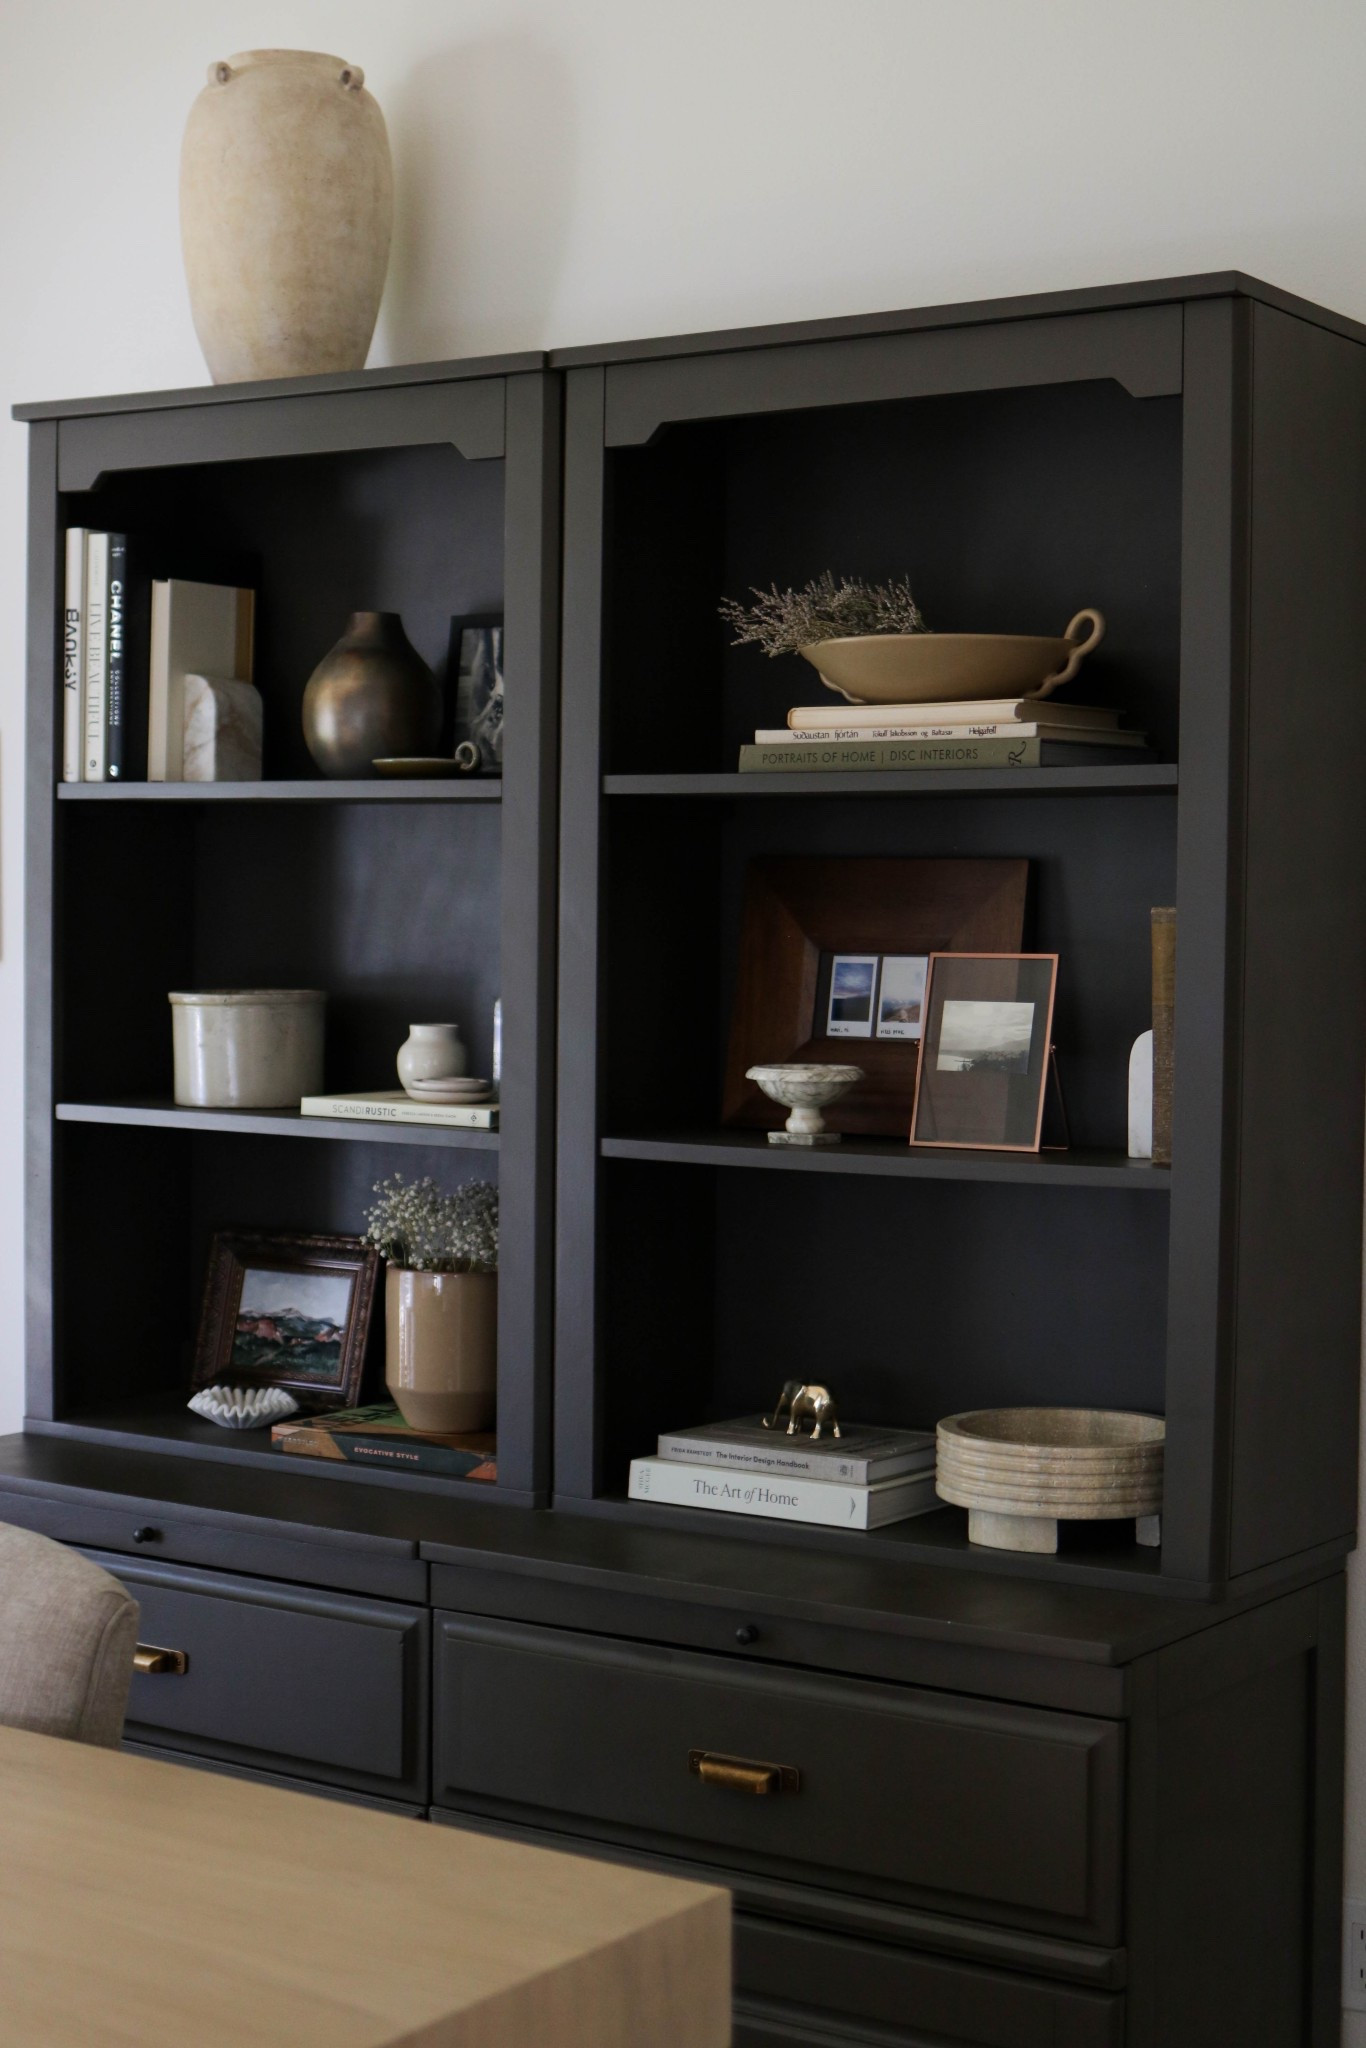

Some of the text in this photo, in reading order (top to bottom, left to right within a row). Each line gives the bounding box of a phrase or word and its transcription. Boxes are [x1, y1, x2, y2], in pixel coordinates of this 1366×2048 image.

[89, 603, 102, 640] LIVE
[110, 580, 122, 664] CHANEL
[792, 731, 830, 740] Suðaustan
[968, 725, 997, 737] Helgafell
[762, 752, 820, 764] PORTRAITS
[821, 752, 838, 763] OF
[840, 750, 876, 763] HOME
[890, 749, 916, 762] DISC
[919, 748, 979, 761] INTERIORS
[353, 1447, 420, 1461] EVOCATIVE STYLE
[716, 1451, 810, 1470] The Interior Design Handbook
[692, 1479, 800, 1507] The Art of Home
